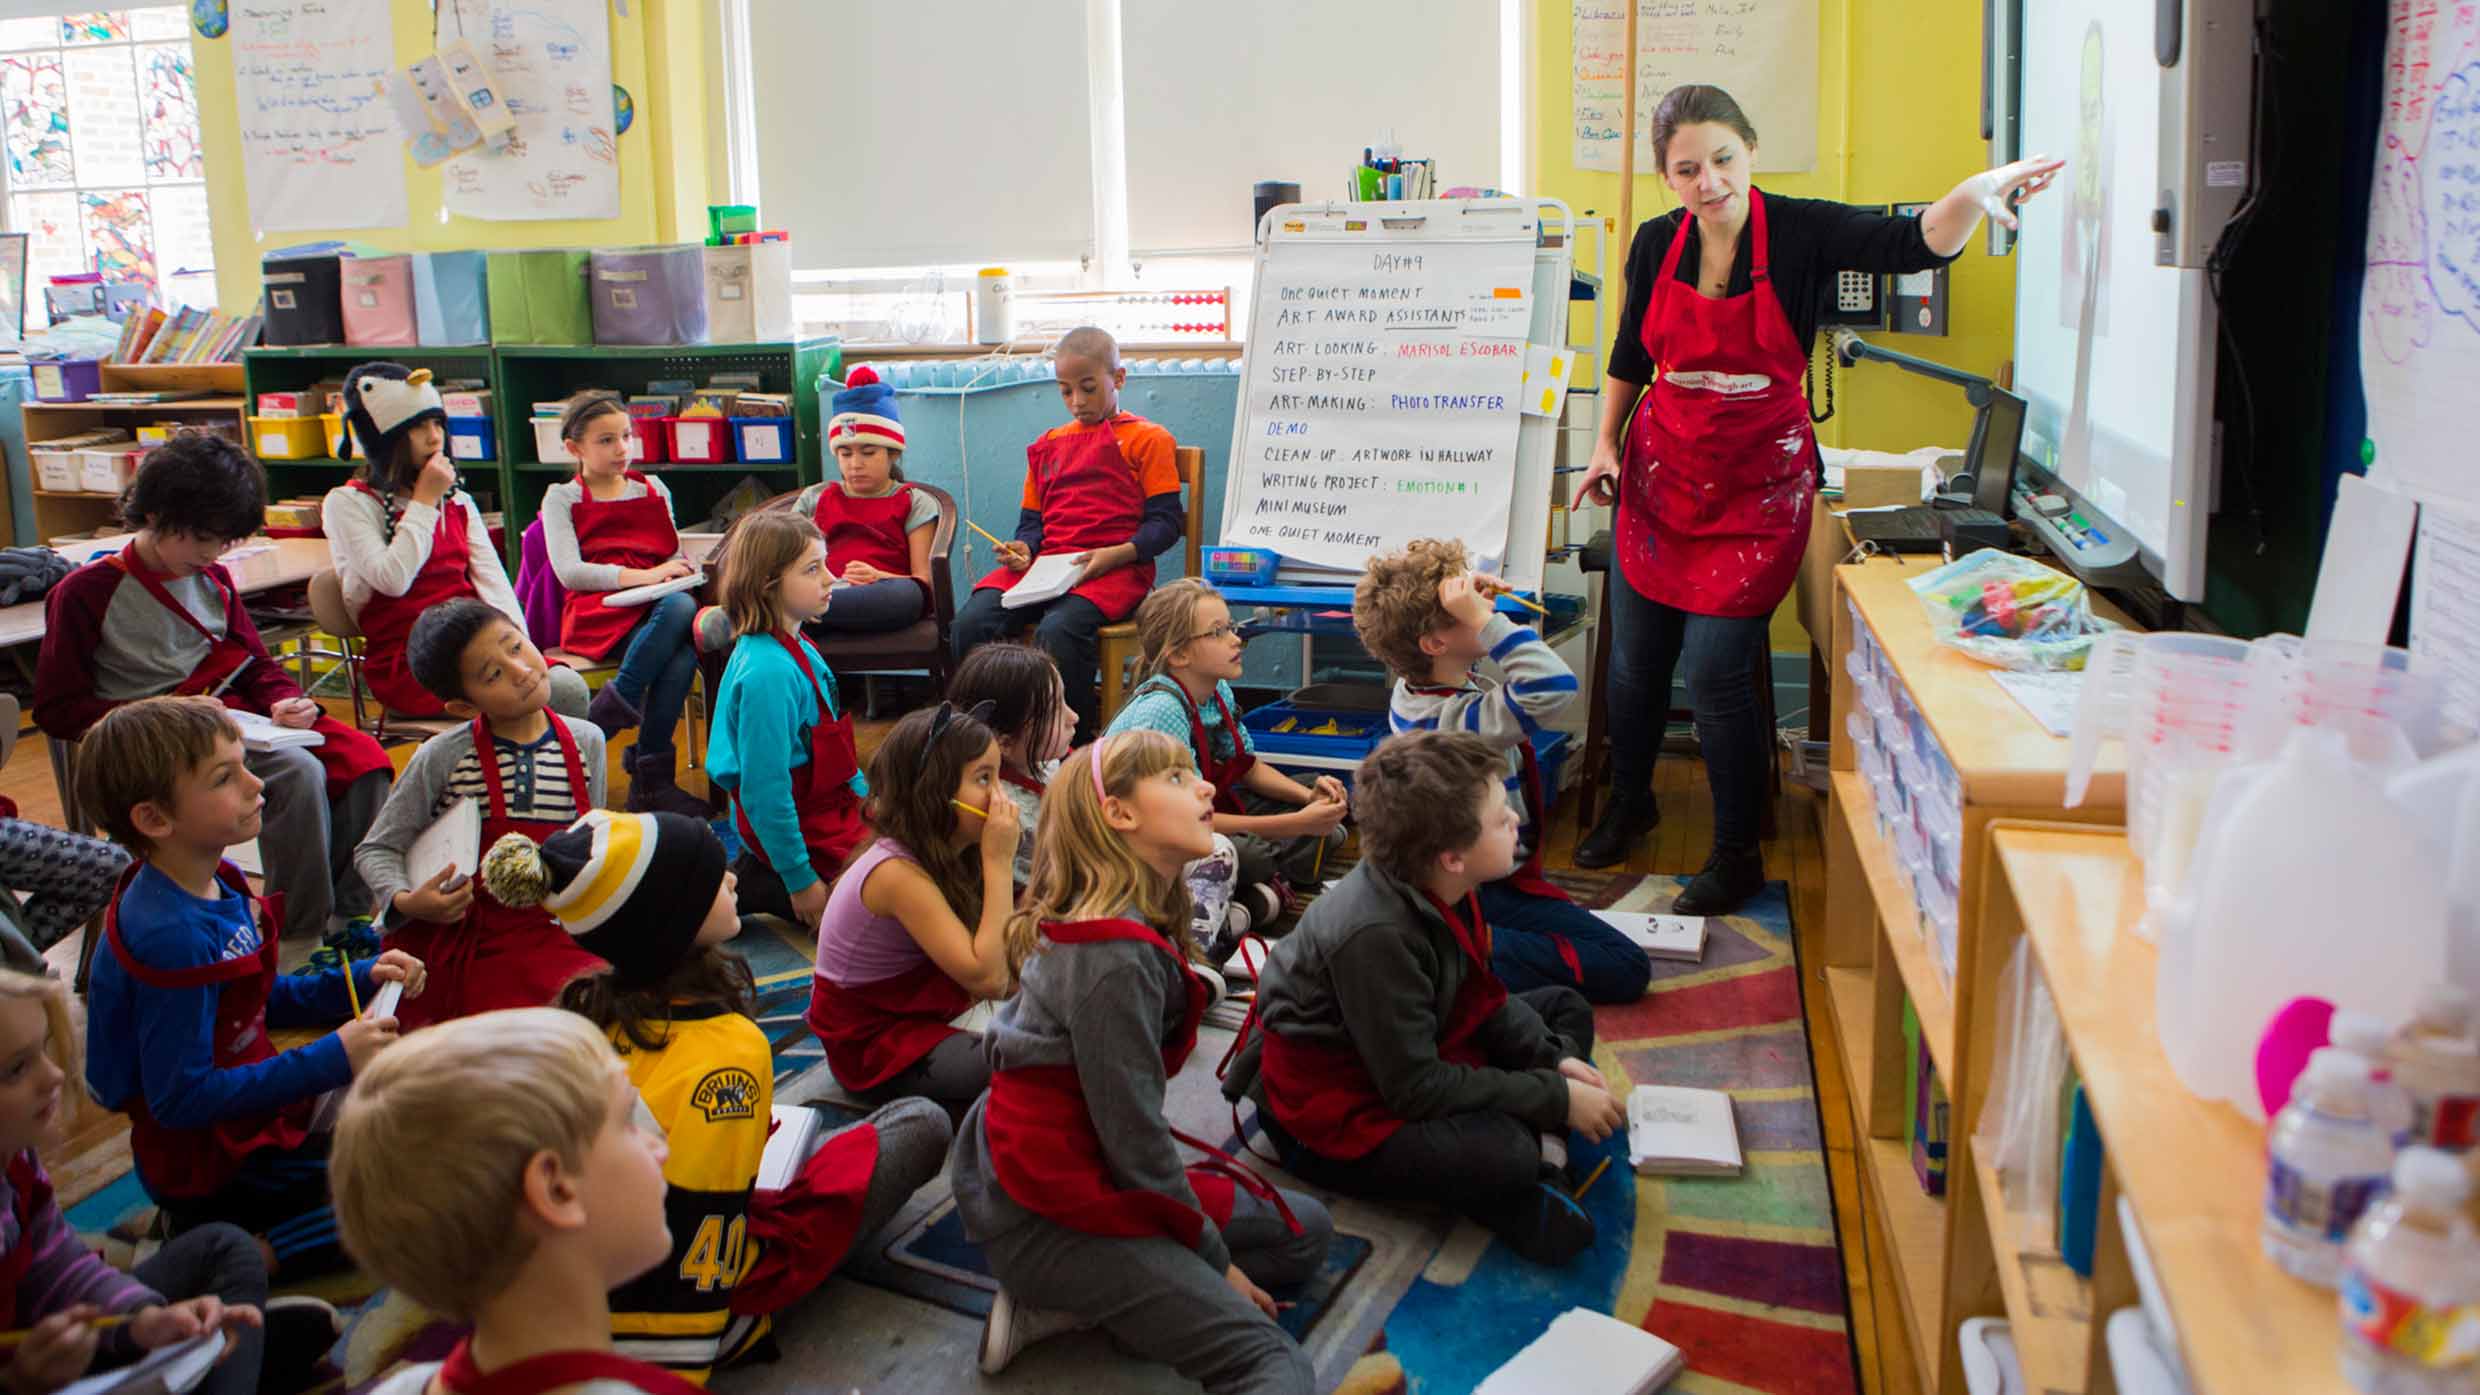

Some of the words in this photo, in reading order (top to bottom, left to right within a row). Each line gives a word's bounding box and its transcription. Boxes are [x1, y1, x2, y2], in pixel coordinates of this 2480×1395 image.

[1276, 308, 1316, 328] ART
[1325, 309, 1378, 323] AWARD
[1398, 343, 1452, 358] MARISOL
[1459, 341, 1519, 357] ESCOBAR
[1432, 394, 1504, 409] TRANSFER
[1267, 421, 1308, 436] DEMO
[1352, 448, 1412, 462] ARTWORK
[1438, 449, 1493, 462] HALLWAY
[1262, 471, 1317, 489] WRITING
[1292, 500, 1347, 516] MUSEUM
[1248, 526, 1273, 537] ONE
[1278, 526, 1321, 541] QUIET
[1323, 531, 1381, 548] MOMENT
[698, 1073, 757, 1104] BRUINS
[680, 1213, 748, 1292] 40
